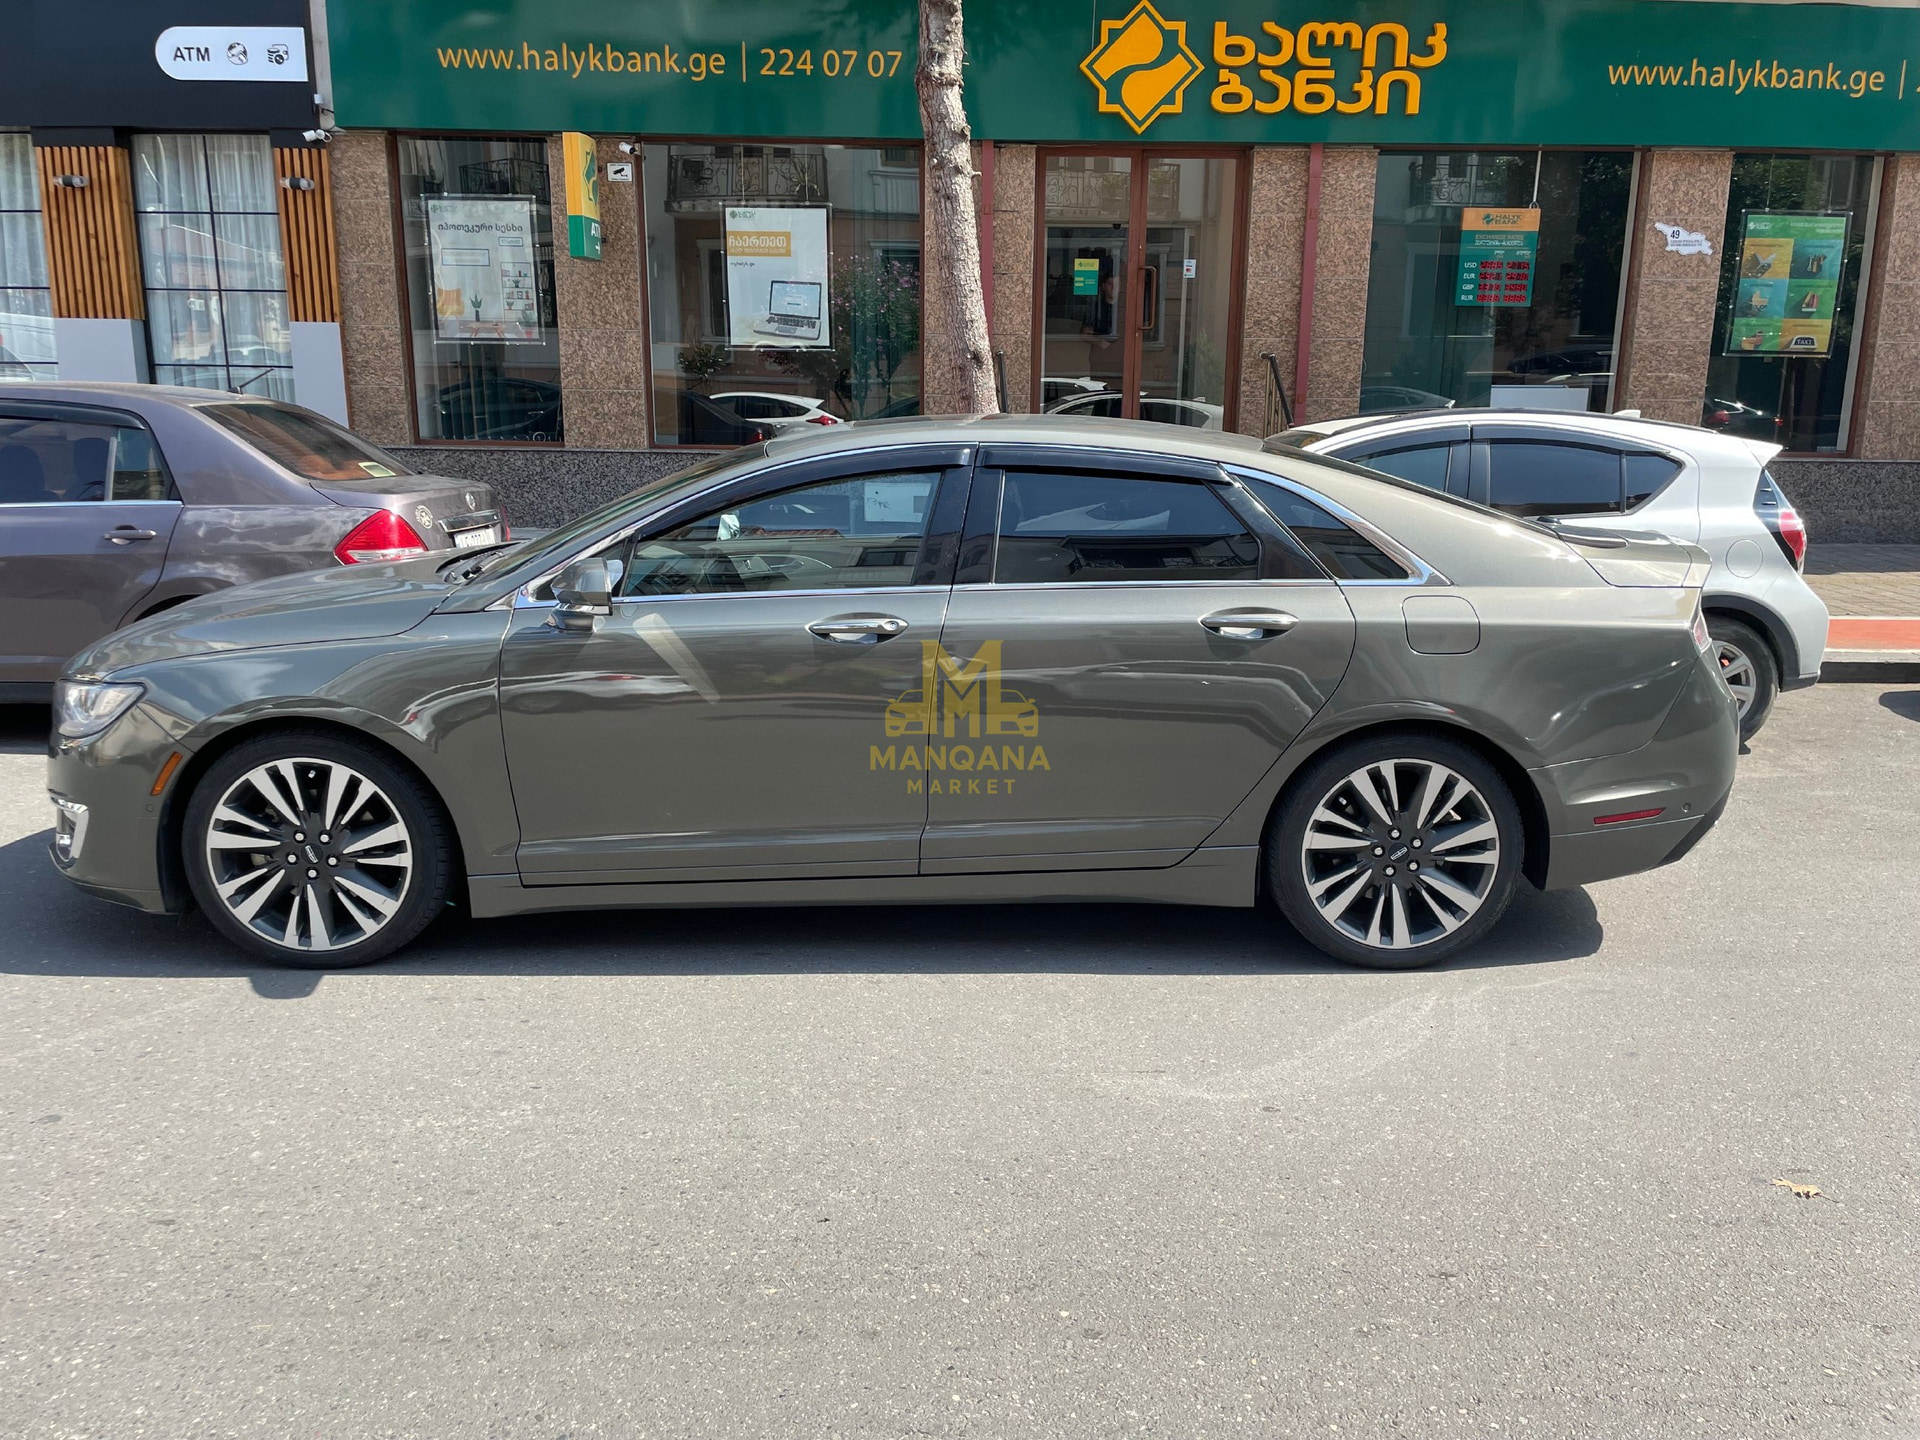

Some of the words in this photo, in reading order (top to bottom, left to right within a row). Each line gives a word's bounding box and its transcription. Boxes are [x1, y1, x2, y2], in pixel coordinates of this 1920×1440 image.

[173, 46, 211, 62] ATM
[436, 42, 726, 81] www.halykbank.ge
[760, 48, 814, 77] 224
[822, 50, 858, 77] 07
[867, 50, 903, 78] 07
[1213, 21, 1447, 68] ხალიკ
[1210, 69, 1421, 116] ბანკი
[1608, 58, 1886, 98] www.halykbank.ge
[438, 222, 493, 233] იპოთეკური
[495, 223, 523, 233] სესხი
[1670, 229, 1680, 239] 49
